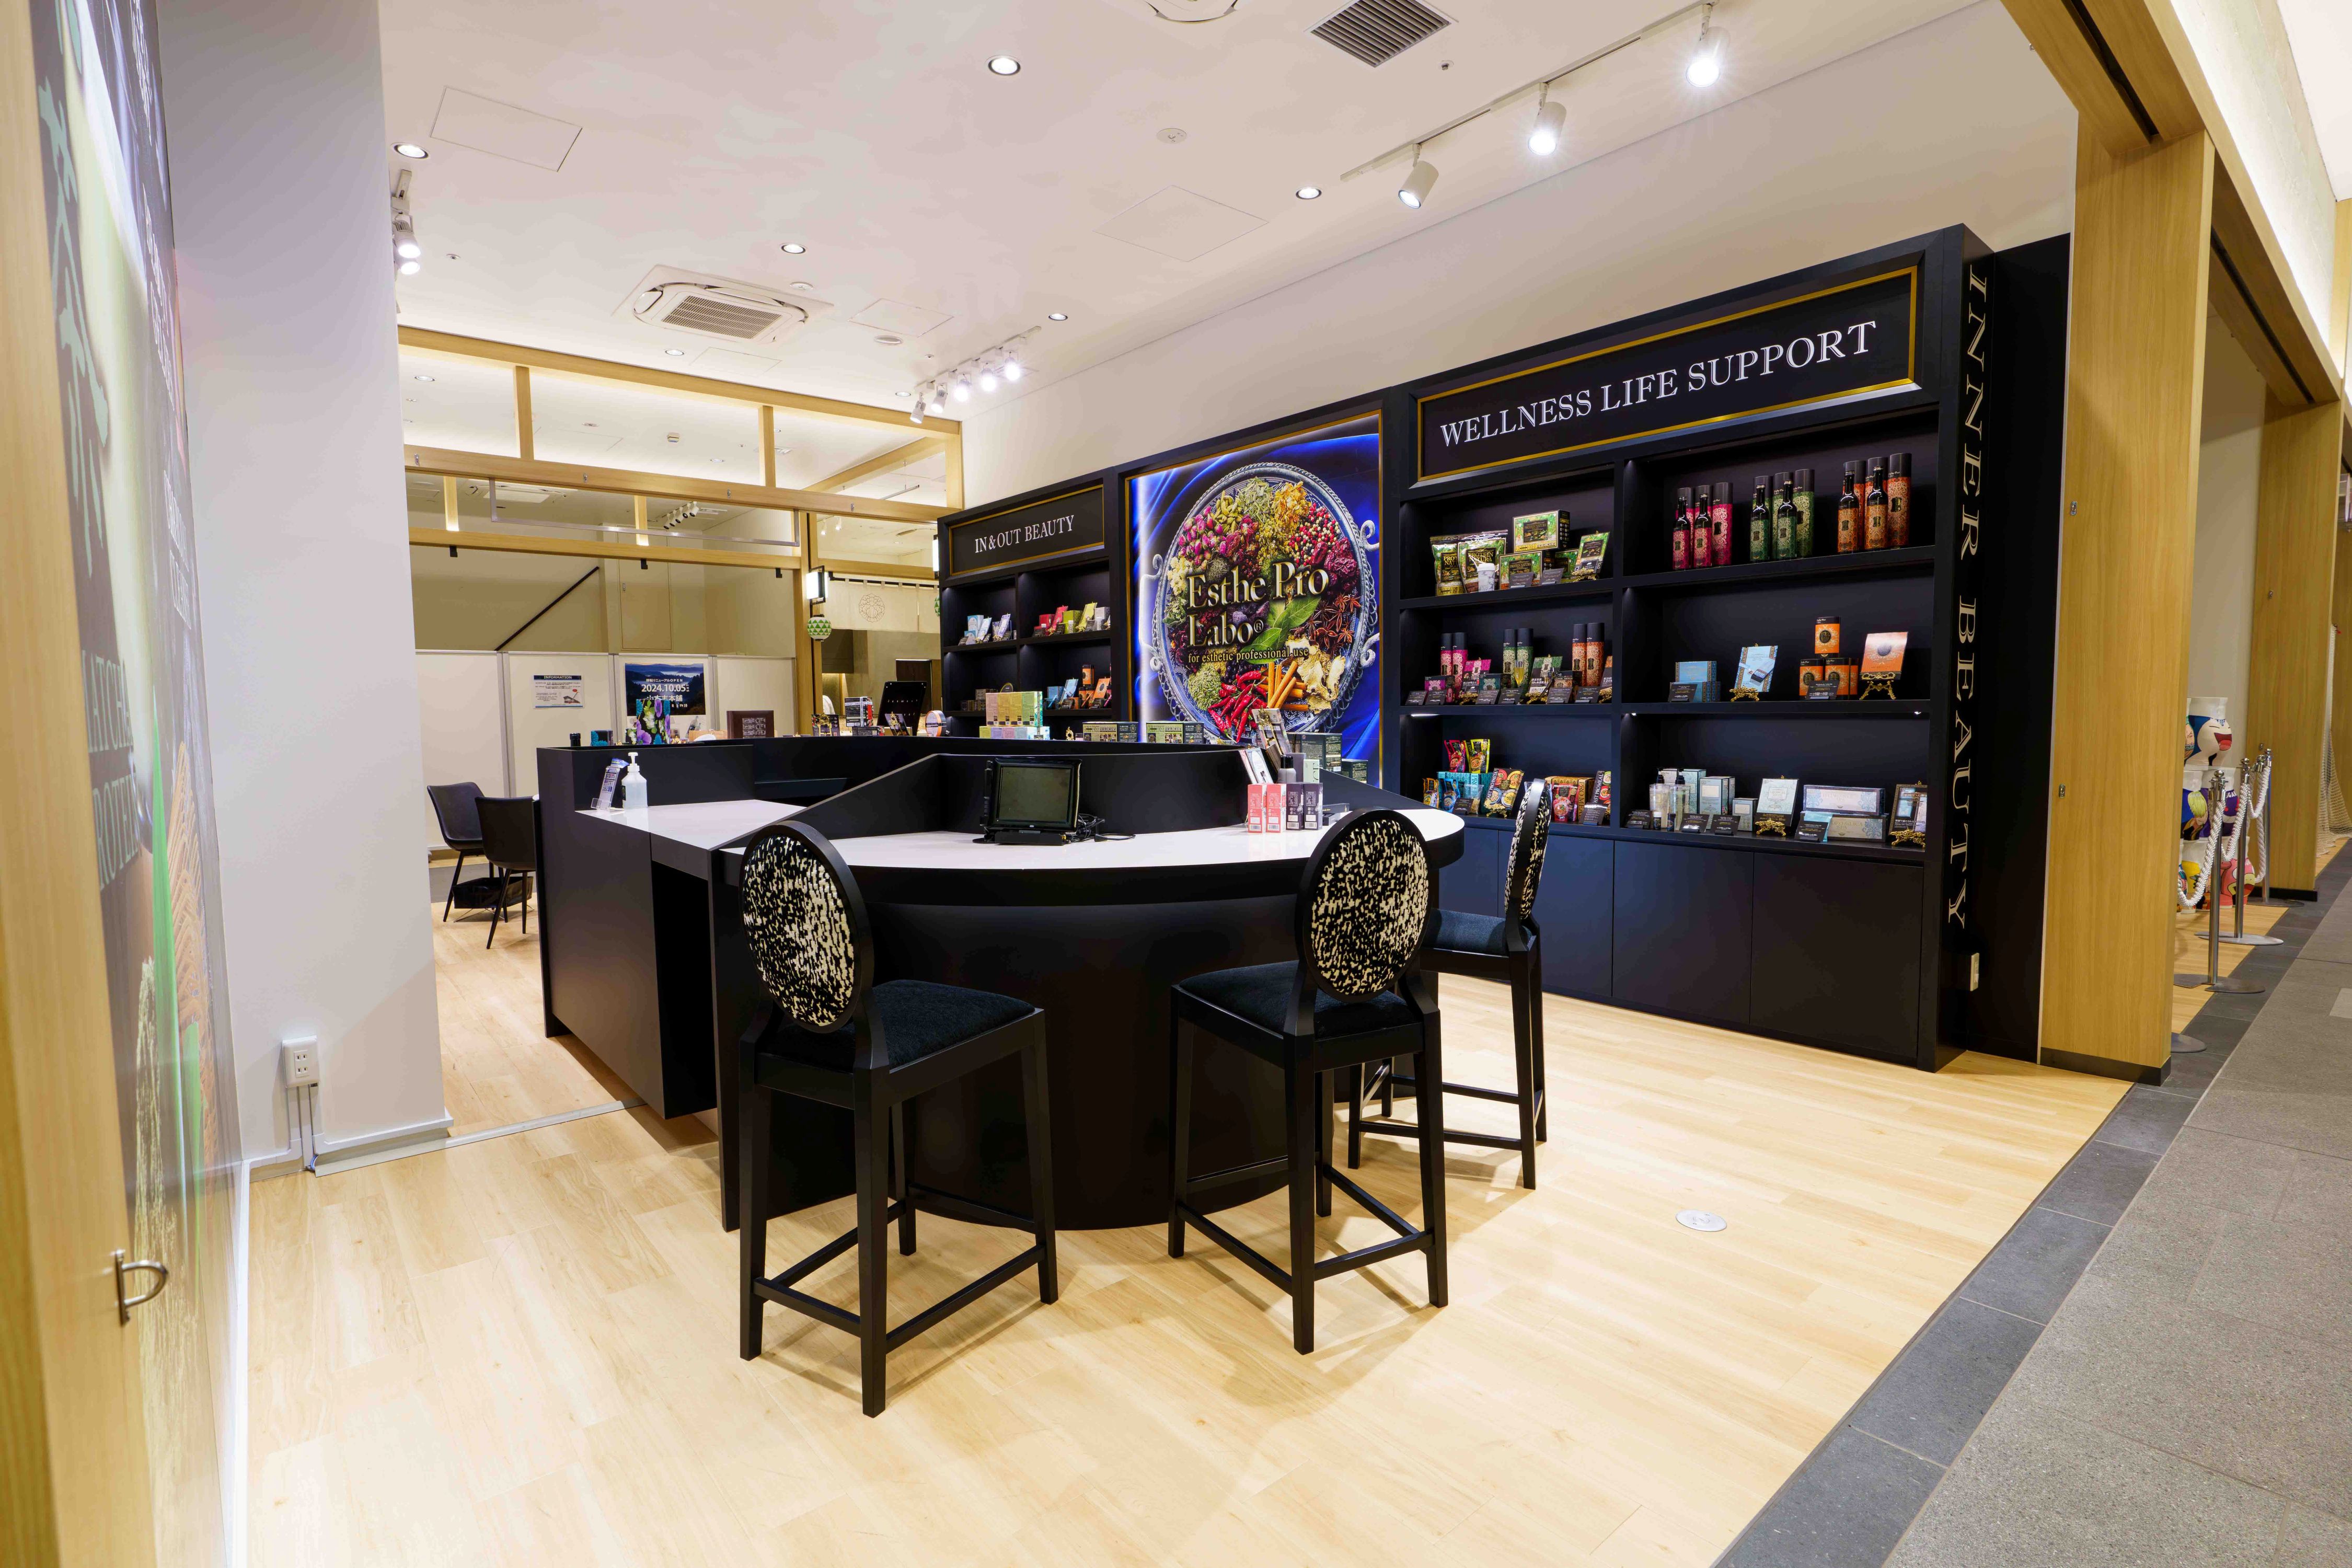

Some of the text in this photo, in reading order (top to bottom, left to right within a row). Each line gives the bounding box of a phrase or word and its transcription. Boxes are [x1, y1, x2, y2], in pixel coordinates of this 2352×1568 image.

[1440, 320, 1877, 447] WELLNESS LIFE SUPPORT
[1024, 514, 1075, 541] BEAUTY
[1187, 561, 1329, 609] Esthe Pro
[1949, 264, 1987, 929] INNER BEAUTY
[641, 684, 686, 692] 2024.10.05
[1188, 647, 1309, 663] for esthetic professional use
[80, 649, 134, 754] ATCHA
[93, 771, 142, 891] ROTEIN
